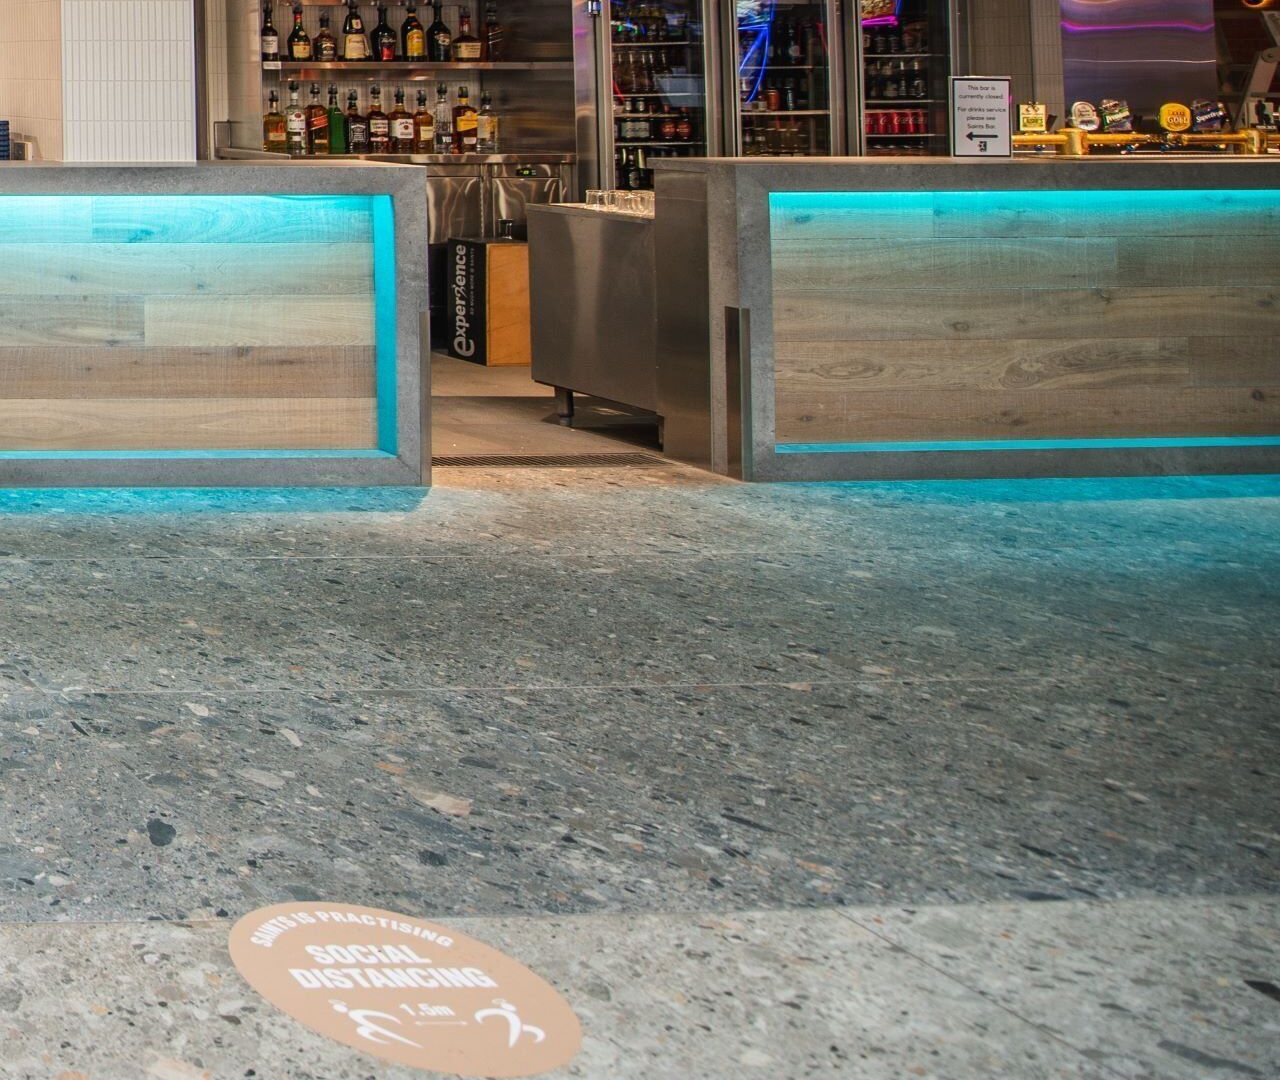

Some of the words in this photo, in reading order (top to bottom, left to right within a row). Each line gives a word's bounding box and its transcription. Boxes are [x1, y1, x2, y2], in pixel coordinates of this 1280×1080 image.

[250, 915, 298, 948] SAINTS
[291, 911, 317, 924] IS
[314, 911, 454, 948] PRACTISING
[304, 944, 433, 964] SOCIAL
[287, 967, 499, 989] DISTANCING
[399, 1002, 456, 1018] 1.5m
